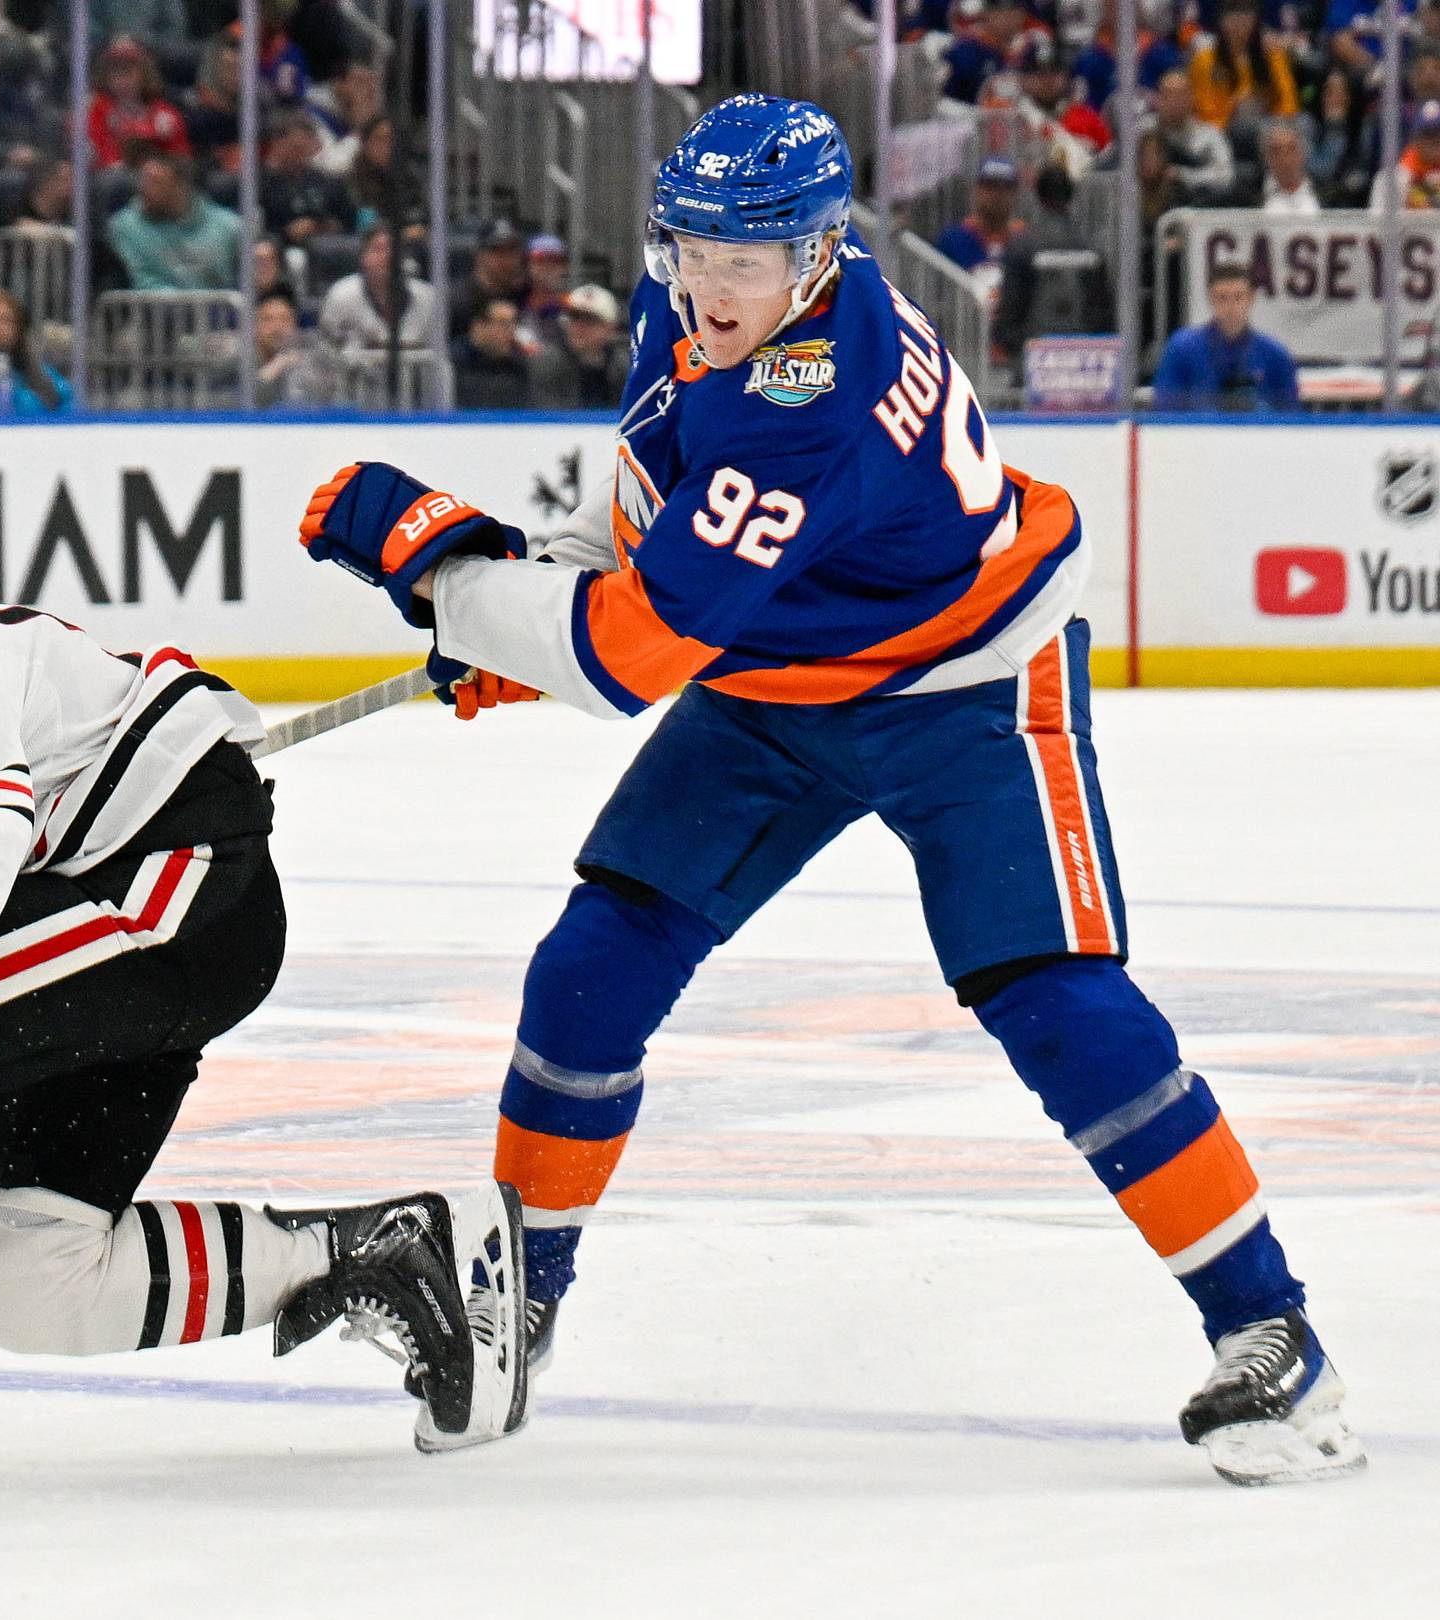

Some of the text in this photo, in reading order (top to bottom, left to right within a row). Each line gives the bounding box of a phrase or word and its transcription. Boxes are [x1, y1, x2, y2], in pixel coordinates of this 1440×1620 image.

[695, 152, 730, 179] 92
[675, 197, 724, 212] BAUER
[692, 466, 806, 569] 92
[1067, 830, 1094, 911] BAUER
[417, 1277, 453, 1334] BAUER
